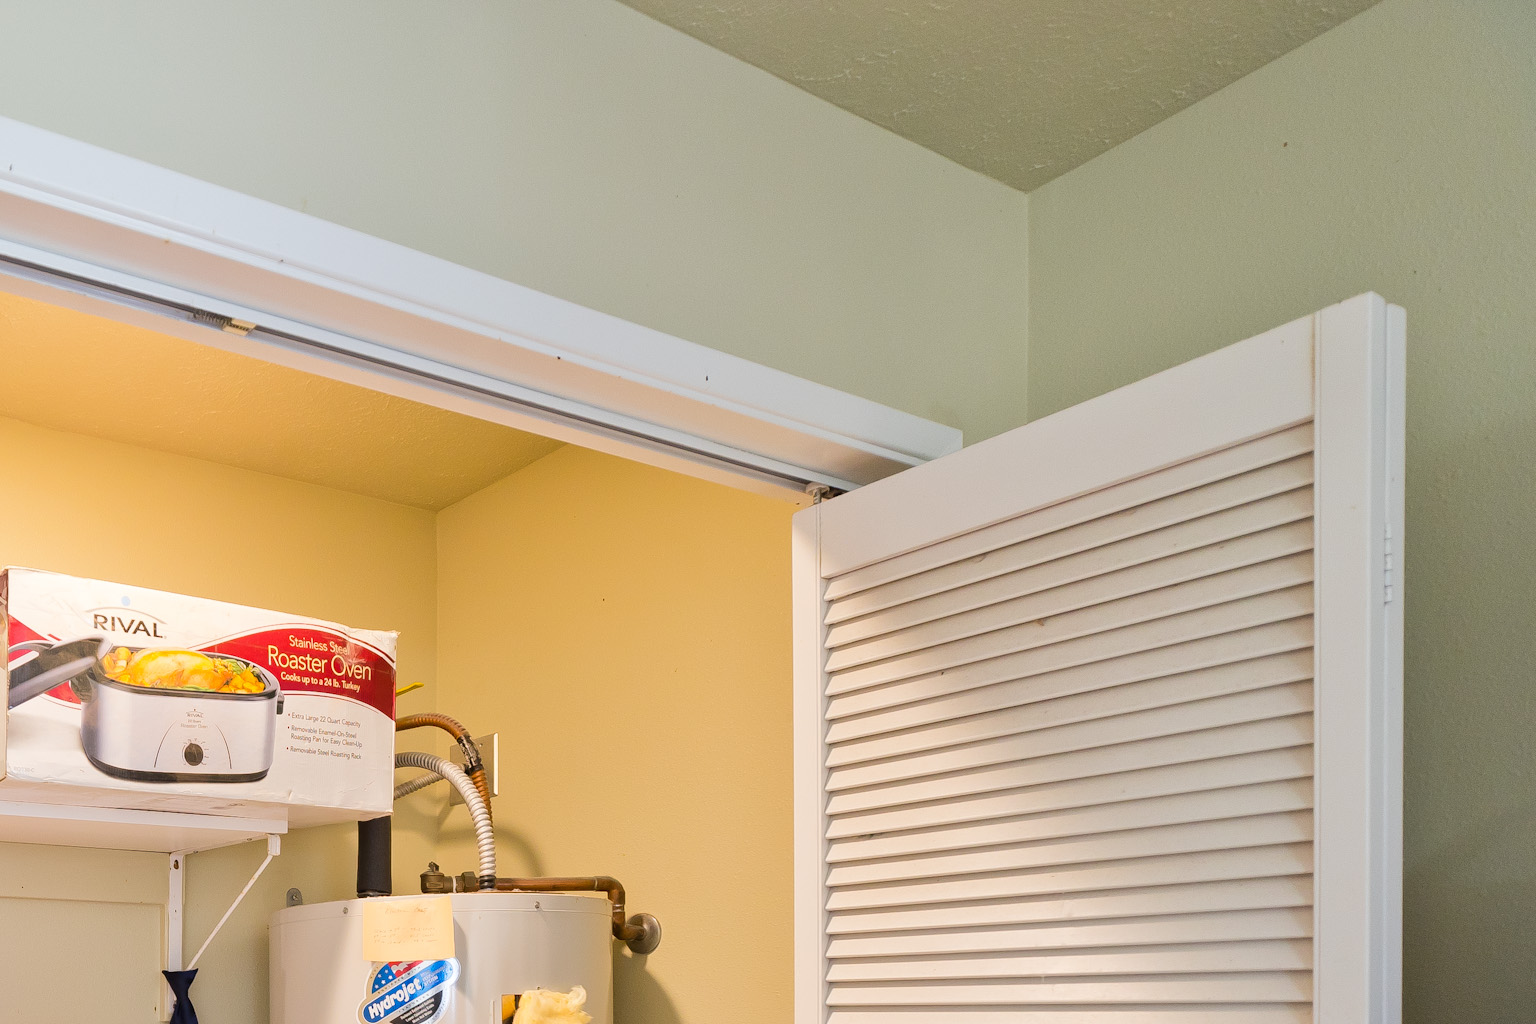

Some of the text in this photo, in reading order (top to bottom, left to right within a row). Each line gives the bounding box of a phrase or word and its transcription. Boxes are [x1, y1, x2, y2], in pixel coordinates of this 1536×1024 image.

[93, 613, 163, 639] RIVAL
[289, 635, 350, 655] Stainless Steel
[268, 645, 372, 680] Roaster Oven
[280, 671, 301, 682] Cooks
[301, 677, 310, 685] up
[311, 677, 318, 685] to
[323, 677, 332, 686] 24
[333, 679, 341, 688] lb.
[341, 680, 361, 693] Turkey
[291, 712, 304, 720] Extra
[305, 714, 319, 723] Large
[327, 716, 341, 725] Quart
[342, 718, 361, 728] Capacity
[291, 725, 318, 734] Removable
[290, 733, 312, 743] Roasting
[330, 737, 341, 746] Easy
[341, 739, 363, 749] Clean-Up
[290, 745, 316, 754] Removable
[330, 750, 351, 760] Roasting
[351, 752, 362, 760] Rack
[368, 977, 423, 1020] Hydrojet
